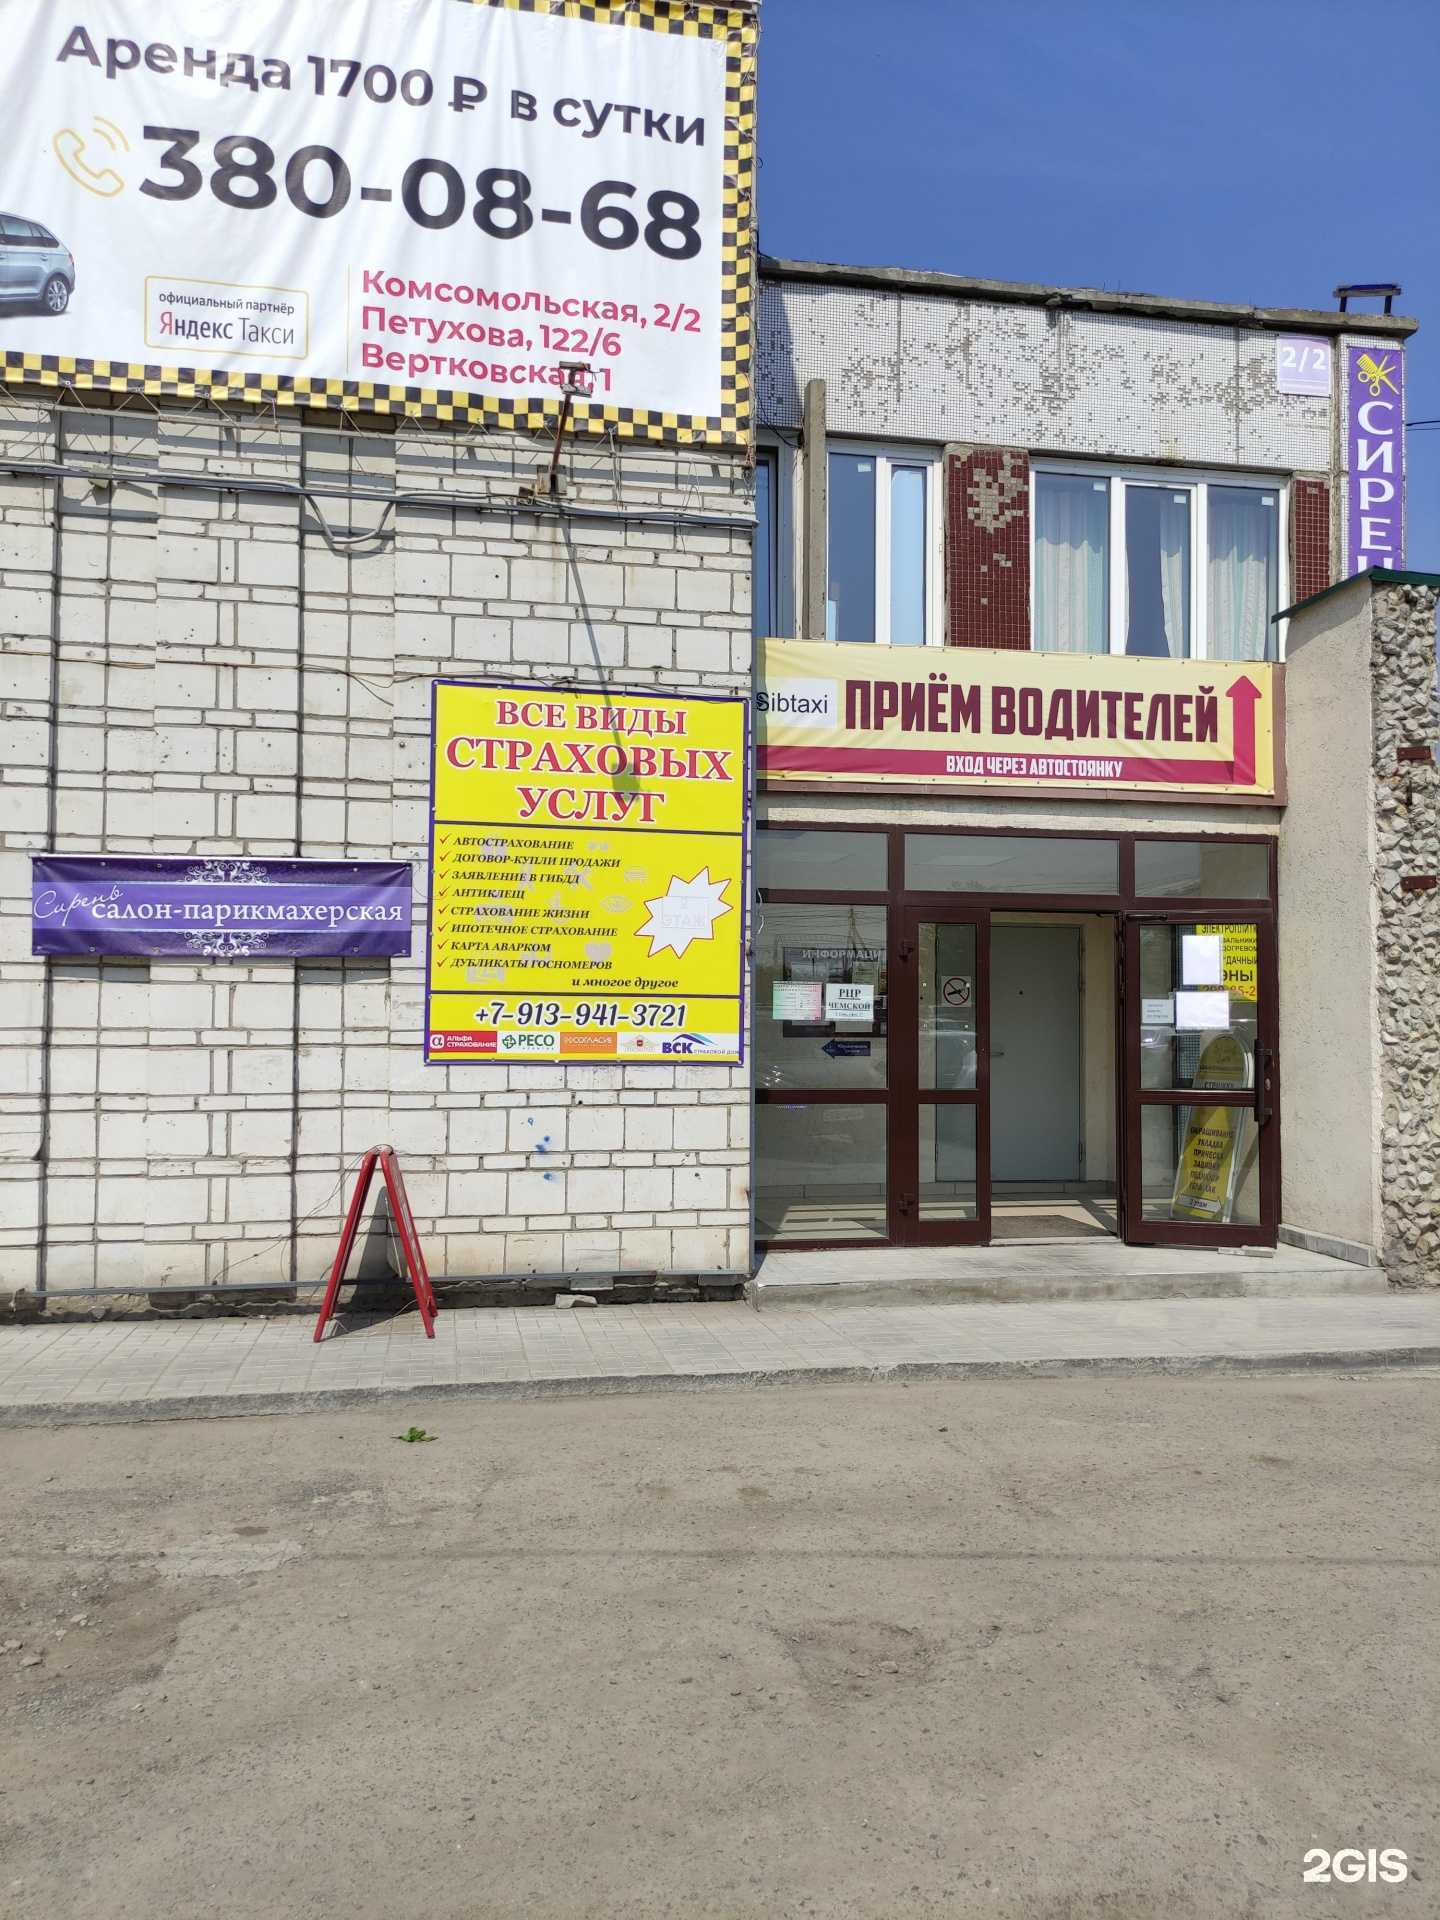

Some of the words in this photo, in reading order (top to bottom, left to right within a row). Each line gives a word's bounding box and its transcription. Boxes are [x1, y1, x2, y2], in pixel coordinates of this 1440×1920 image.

[56, 25, 292, 93] Аренда
[307, 55, 434, 107] 1700
[511, 90, 538, 122] в
[553, 98, 705, 147] сутки
[140, 126, 702, 261] 380-08-68
[159, 292, 243, 310] официальный
[246, 301, 295, 315] партнёр
[363, 270, 647, 329] Комсомольская,
[653, 303, 701, 333] 2/2
[160, 311, 234, 340] Яндекс
[238, 317, 295, 345] Такси
[362, 306, 533, 352] Петухова,
[539, 325, 623, 358] 122/6
[1282, 346, 1327, 373] 2/2
[756, 691, 828, 714] Sibtaxi
[845, 672, 981, 734] ПРИЁМ
[992, 685, 1219, 743] ВОДИТЕЛЕЙ
[496, 700, 566, 729] ВСЕ
[576, 705, 687, 737] ВИДЫ
[446, 737, 733, 781] СТРАХОВЫХ
[946, 755, 984, 774] ВХОД
[986, 757, 1026, 775] ЧЕРЕЗ
[1029, 758, 1123, 778] АВТОСТОЯНКУ
[517, 787, 665, 823] УСЛУГ
[453, 837, 574, 850] АВТОСТРАХОВАНИЕ
[452, 853, 557, 866] ДОГОВОР-КУПЛИ
[559, 857, 621, 868] ПРОДАЖИ
[451, 870, 529, 882] ЗАЯВЛЕНИЕ
[529, 873, 537, 882] В
[539, 872, 581, 885] ГИБДД
[34, 883, 123, 927] Сирень
[452, 888, 525, 900] АНТИКЛЕЩ
[92, 900, 403, 928] салон-парикмахерская
[450, 907, 540, 918] СТРАХОВАНИЕ
[543, 908, 590, 919] ЖИЗНИ
[450, 923, 528, 935] ИПОТЕЧНОЕ
[530, 926, 618, 937] СТРАХОВАНИЕ
[450, 940, 490, 951] КАРТА
[492, 942, 552, 953] АВАРКОМ
[450, 958, 529, 969] ДУБЛИКАТЫ
[530, 959, 613, 970] ГОСНОМЕРОВ
[571, 979, 581, 987] и
[582, 979, 632, 988] многое
[634, 977, 679, 990] другое
[475, 1001, 686, 1027] +7-913-941-3721
[518, 1034, 554, 1047] РЕСО
[661, 1042, 694, 1054] ВСК
